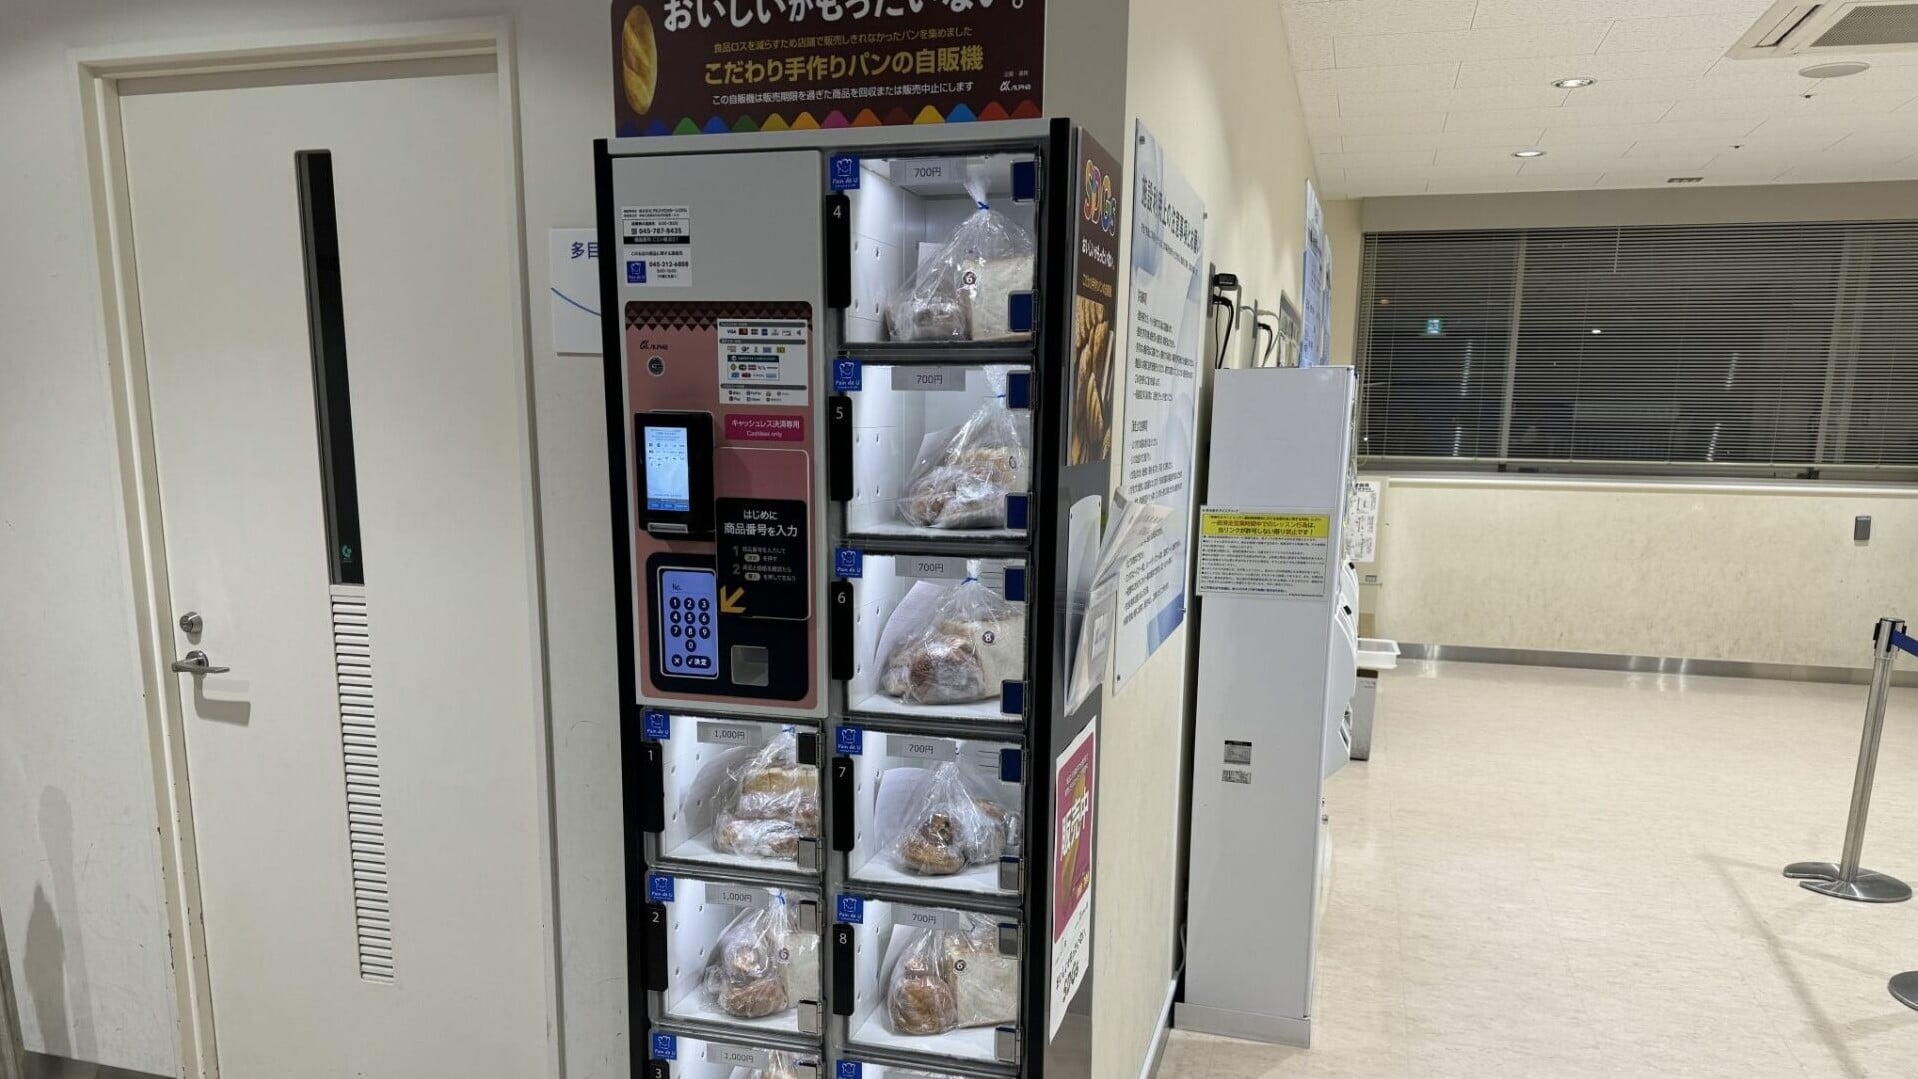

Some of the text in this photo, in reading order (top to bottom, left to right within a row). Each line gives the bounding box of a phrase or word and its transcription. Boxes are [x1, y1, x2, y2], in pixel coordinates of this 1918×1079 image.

[664, 0, 1024, 32] おいしいがもったい。
[705, 45, 984, 85] こだわり手作りパンの自販機
[713, 81, 974, 105] この自販機は販売期限を過ぎた商品を回収または販売中止にします
[914, 167, 942, 178] 700円
[833, 205, 842, 218] 4
[916, 374, 943, 385] 700円
[835, 406, 844, 420] 5
[731, 420, 800, 430] キャッシュレス決済専用
[770, 431, 783, 439] only
[743, 509, 778, 520] はじめに
[723, 522, 798, 537] 商品番号を入力
[732, 563, 741, 575] 2
[918, 563, 944, 573] 700円
[837, 592, 846, 604] 6
[714, 730, 745, 739] 1,000円
[909, 744, 934, 755] 700円
[648, 750, 653, 761] 1
[838, 766, 847, 778] 7
[1062, 788, 1090, 861] 販売中
[722, 892, 752, 903] 1,000円
[652, 912, 660, 923] 2
[912, 913, 937, 924] 700円
[839, 932, 847, 945] 8
[724, 1052, 754, 1063] 1,000円
[655, 1069, 662, 1079] 3
